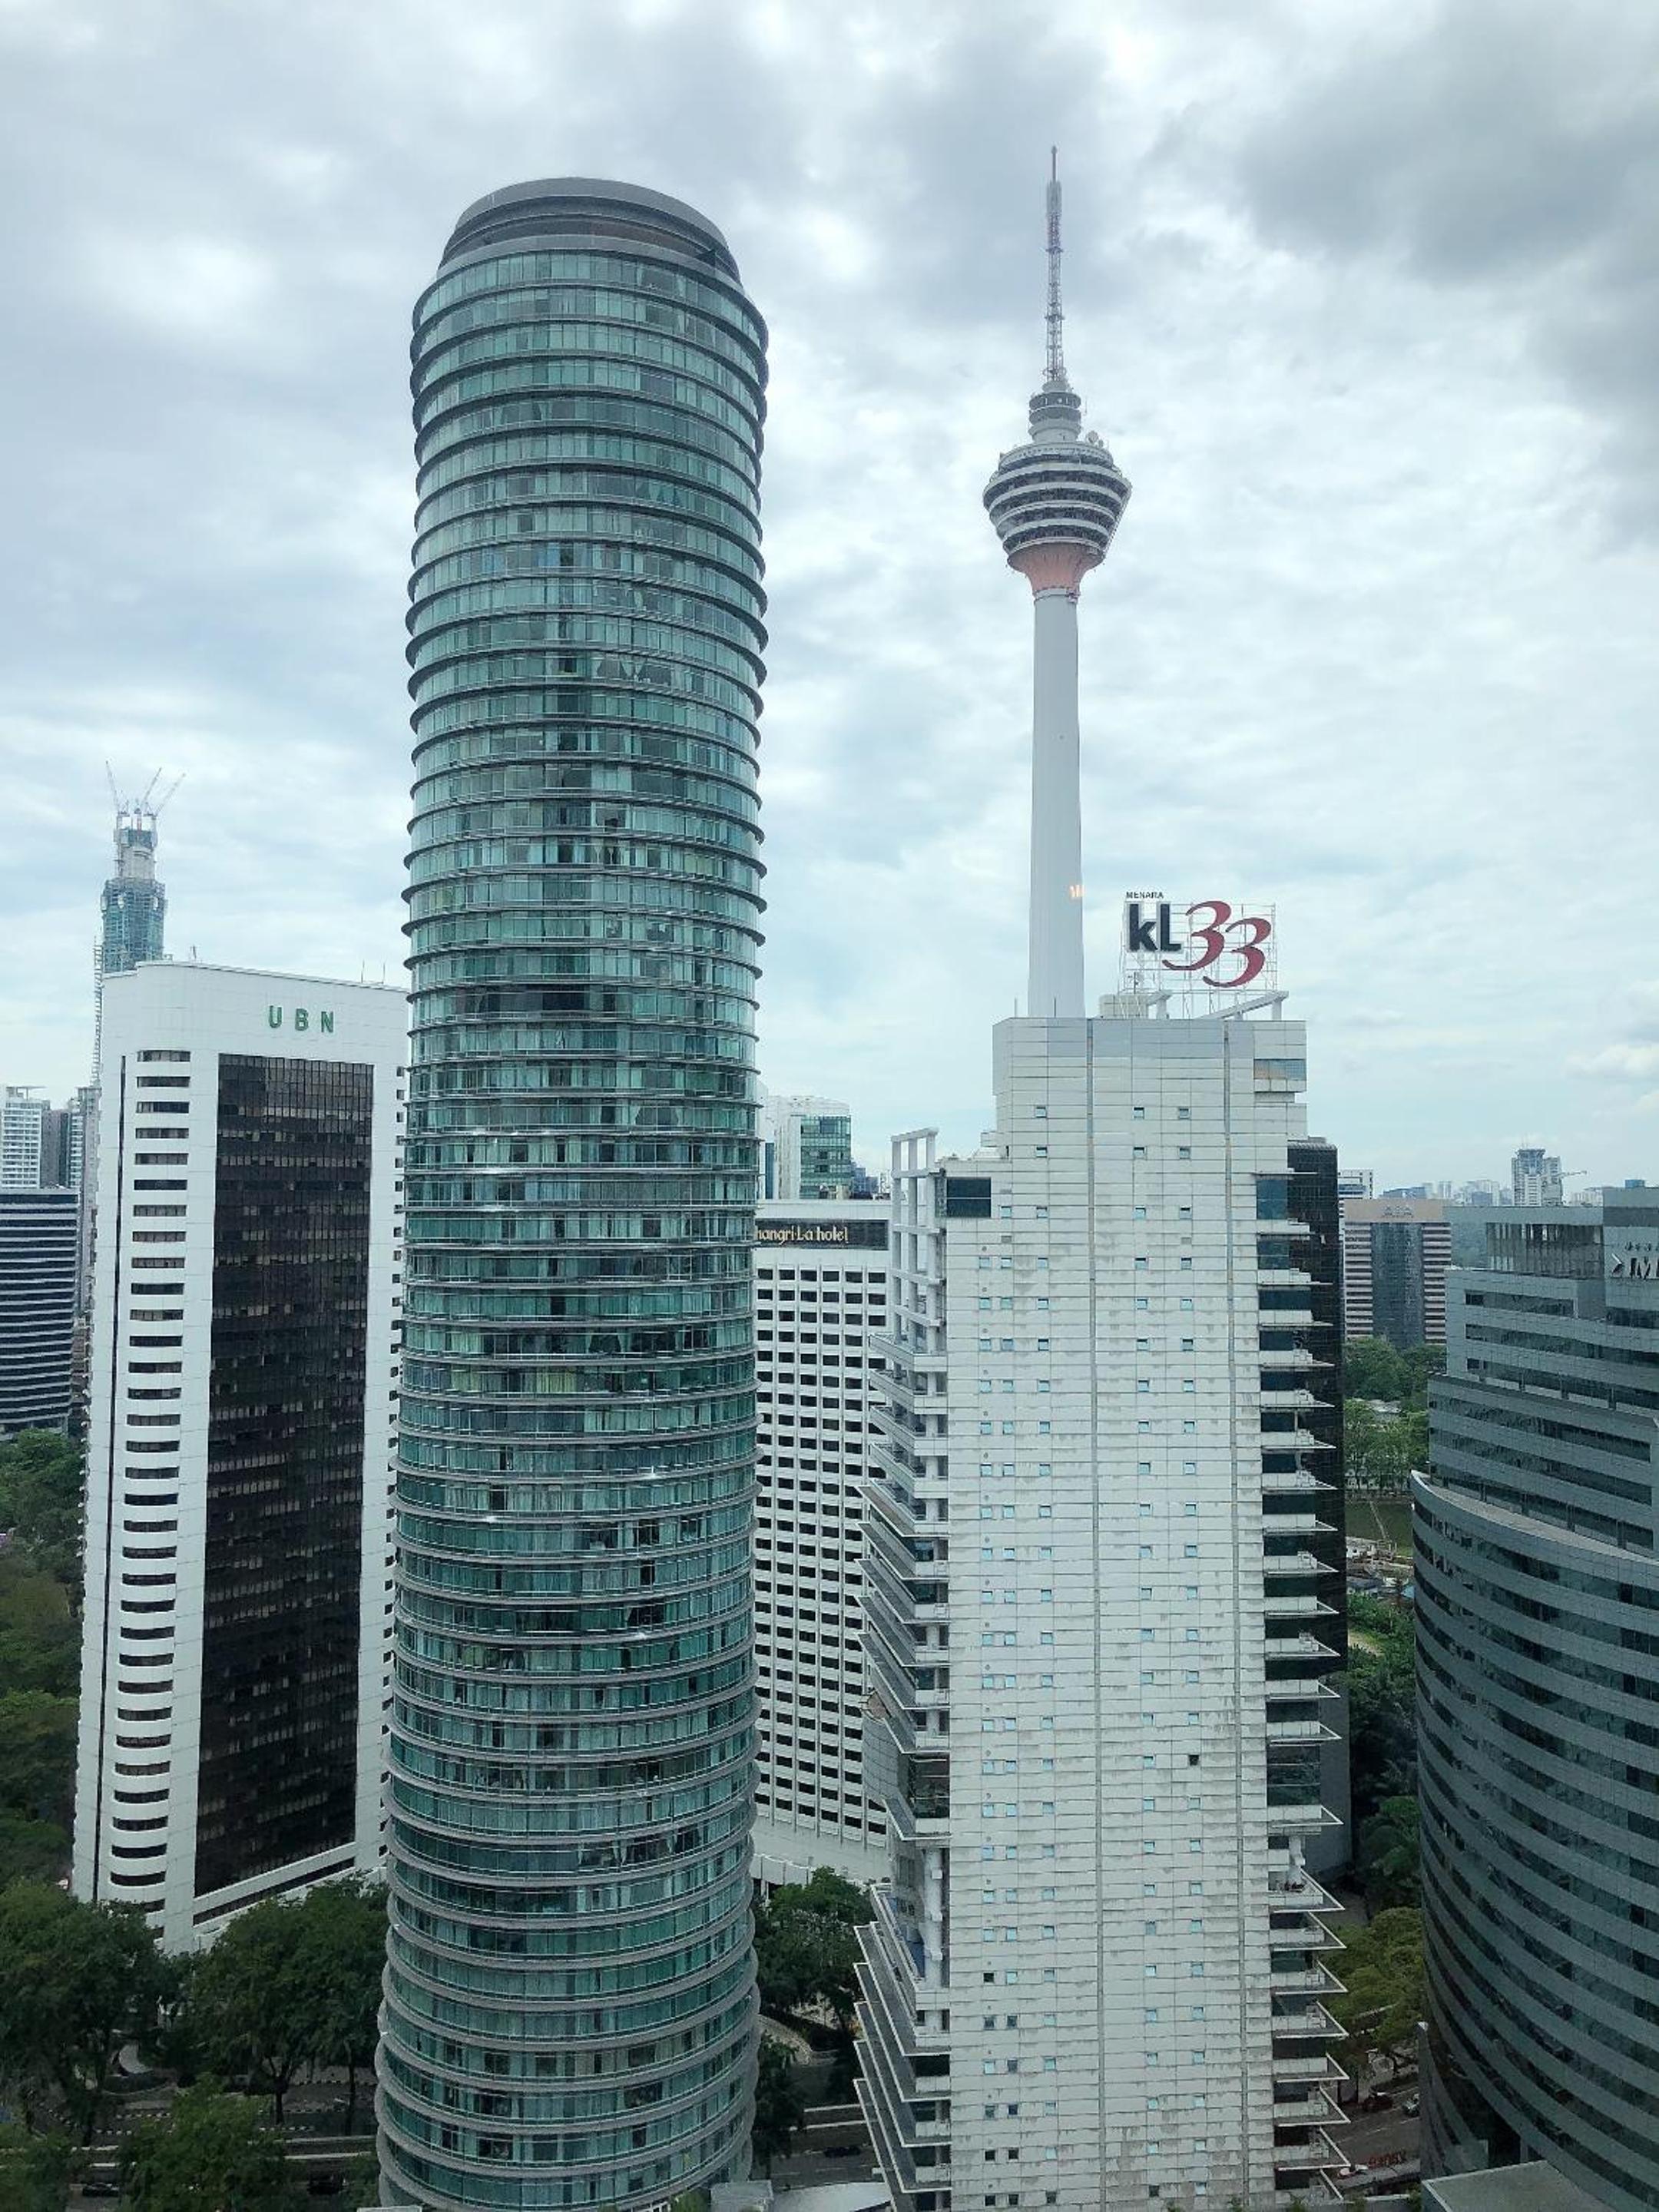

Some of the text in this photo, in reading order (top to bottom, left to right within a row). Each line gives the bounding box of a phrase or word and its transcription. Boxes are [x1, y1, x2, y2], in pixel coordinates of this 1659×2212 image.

[1126, 891, 1164, 899] MENARA
[268, 1005, 334, 1034] UBN
[755, 1225, 813, 1245] hangri-La
